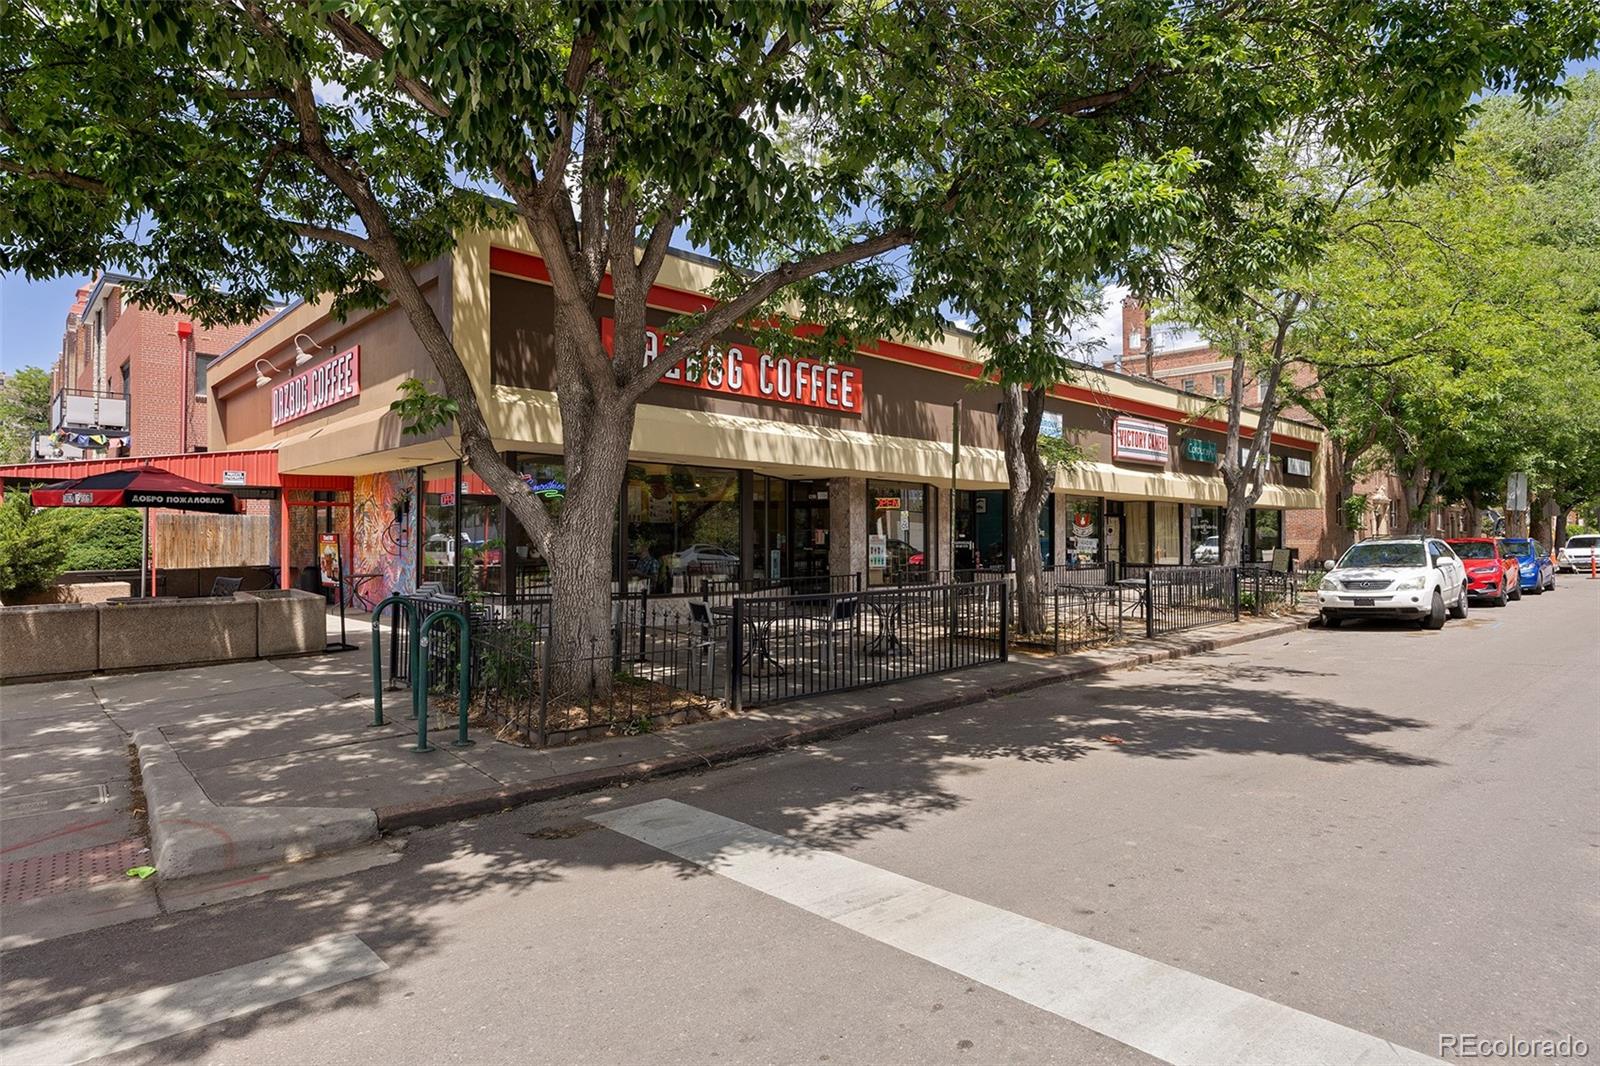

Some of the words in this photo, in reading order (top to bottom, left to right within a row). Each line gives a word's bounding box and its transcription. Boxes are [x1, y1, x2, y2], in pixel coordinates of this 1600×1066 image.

[273, 375, 308, 423] DAZBOG
[311, 352, 354, 407] COFFEE
[642, 331, 743, 390] ABOG
[759, 354, 854, 408] COFFEE
[1118, 429, 1147, 449] VICTORY
[131, 494, 164, 503] ДОБРО
[166, 496, 225, 504] ПОЖАЛОВАТЬ
